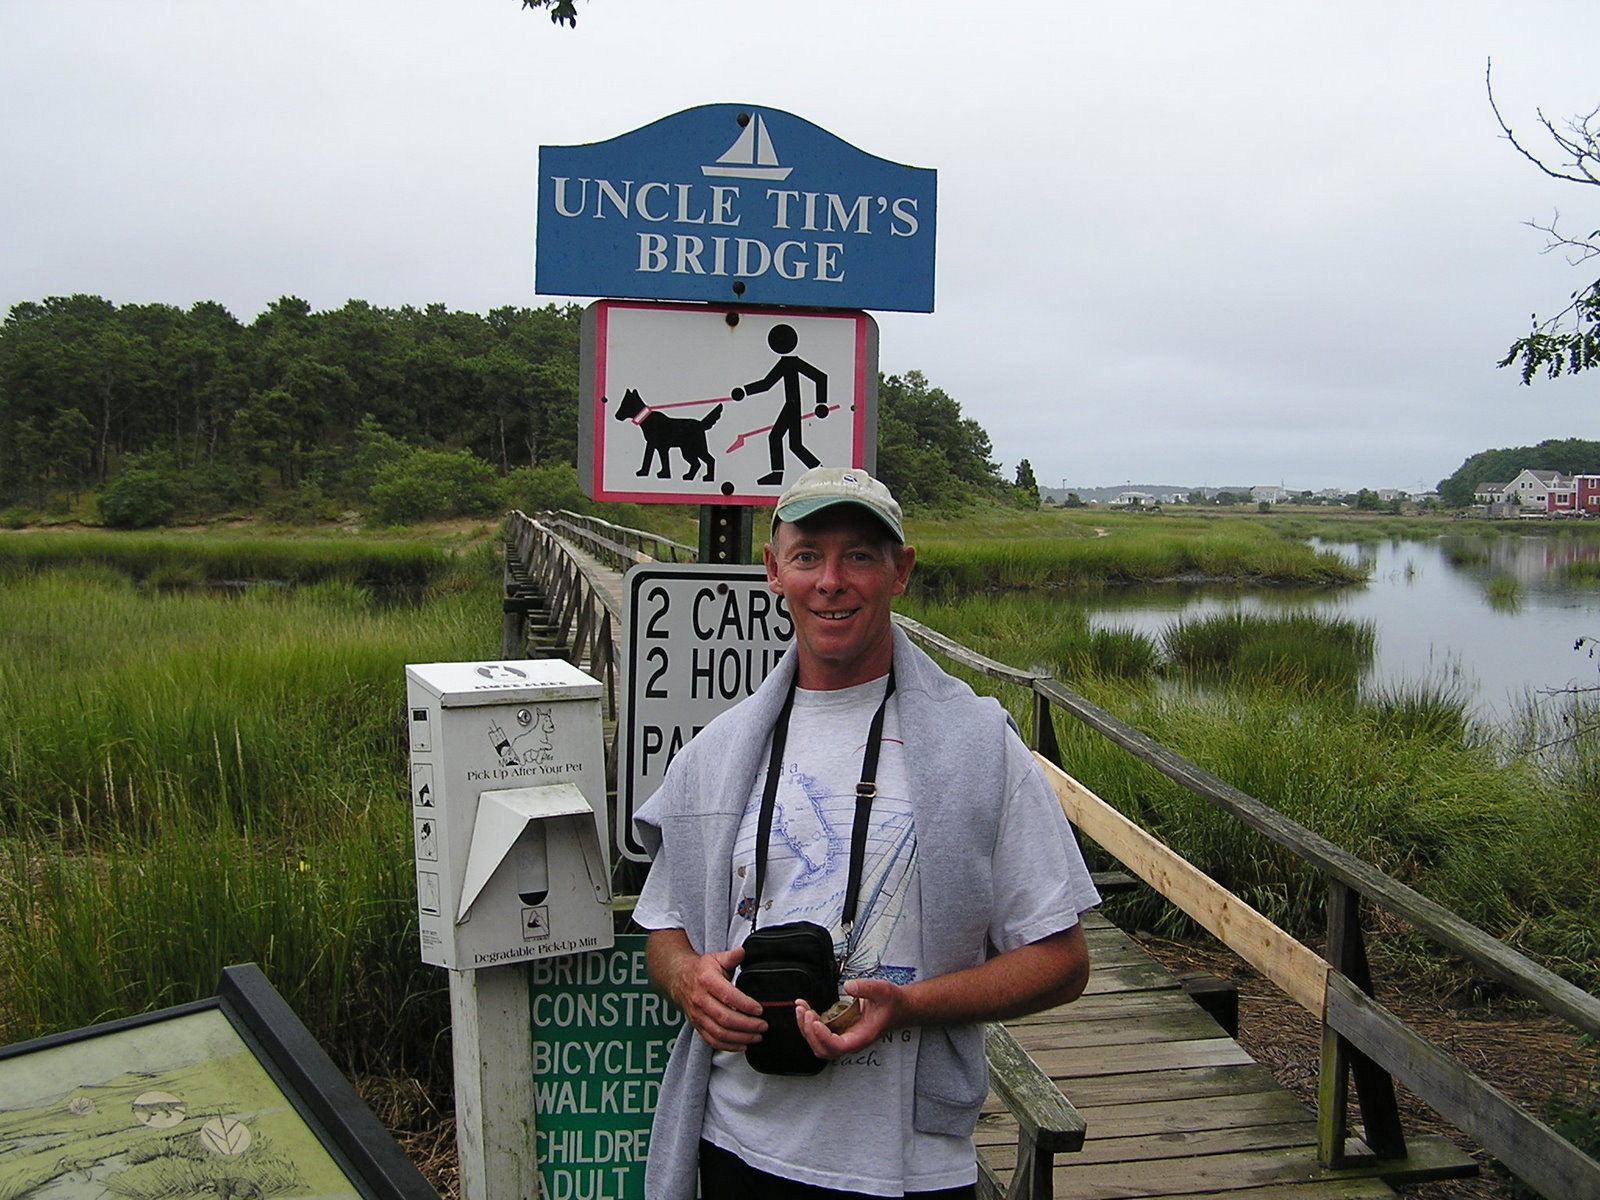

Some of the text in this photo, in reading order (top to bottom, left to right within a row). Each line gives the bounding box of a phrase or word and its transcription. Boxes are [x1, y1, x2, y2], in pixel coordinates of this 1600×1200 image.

[550, 176, 920, 237] UNCLE TIM'S
[635, 232, 846, 283] BRIDGE
[646, 586, 796, 641] 2 CARS
[645, 646, 787, 700] 2 HOU
[467, 763, 582, 780] Pick Up After Your Pet
[642, 726, 705, 776] PA
[474, 937, 597, 963] Degradable Pick-Up Mitt
[533, 951, 649, 985] BRIDGE
[533, 1080, 662, 1114] WALKED
[538, 1167, 630, 1200] ADULT
